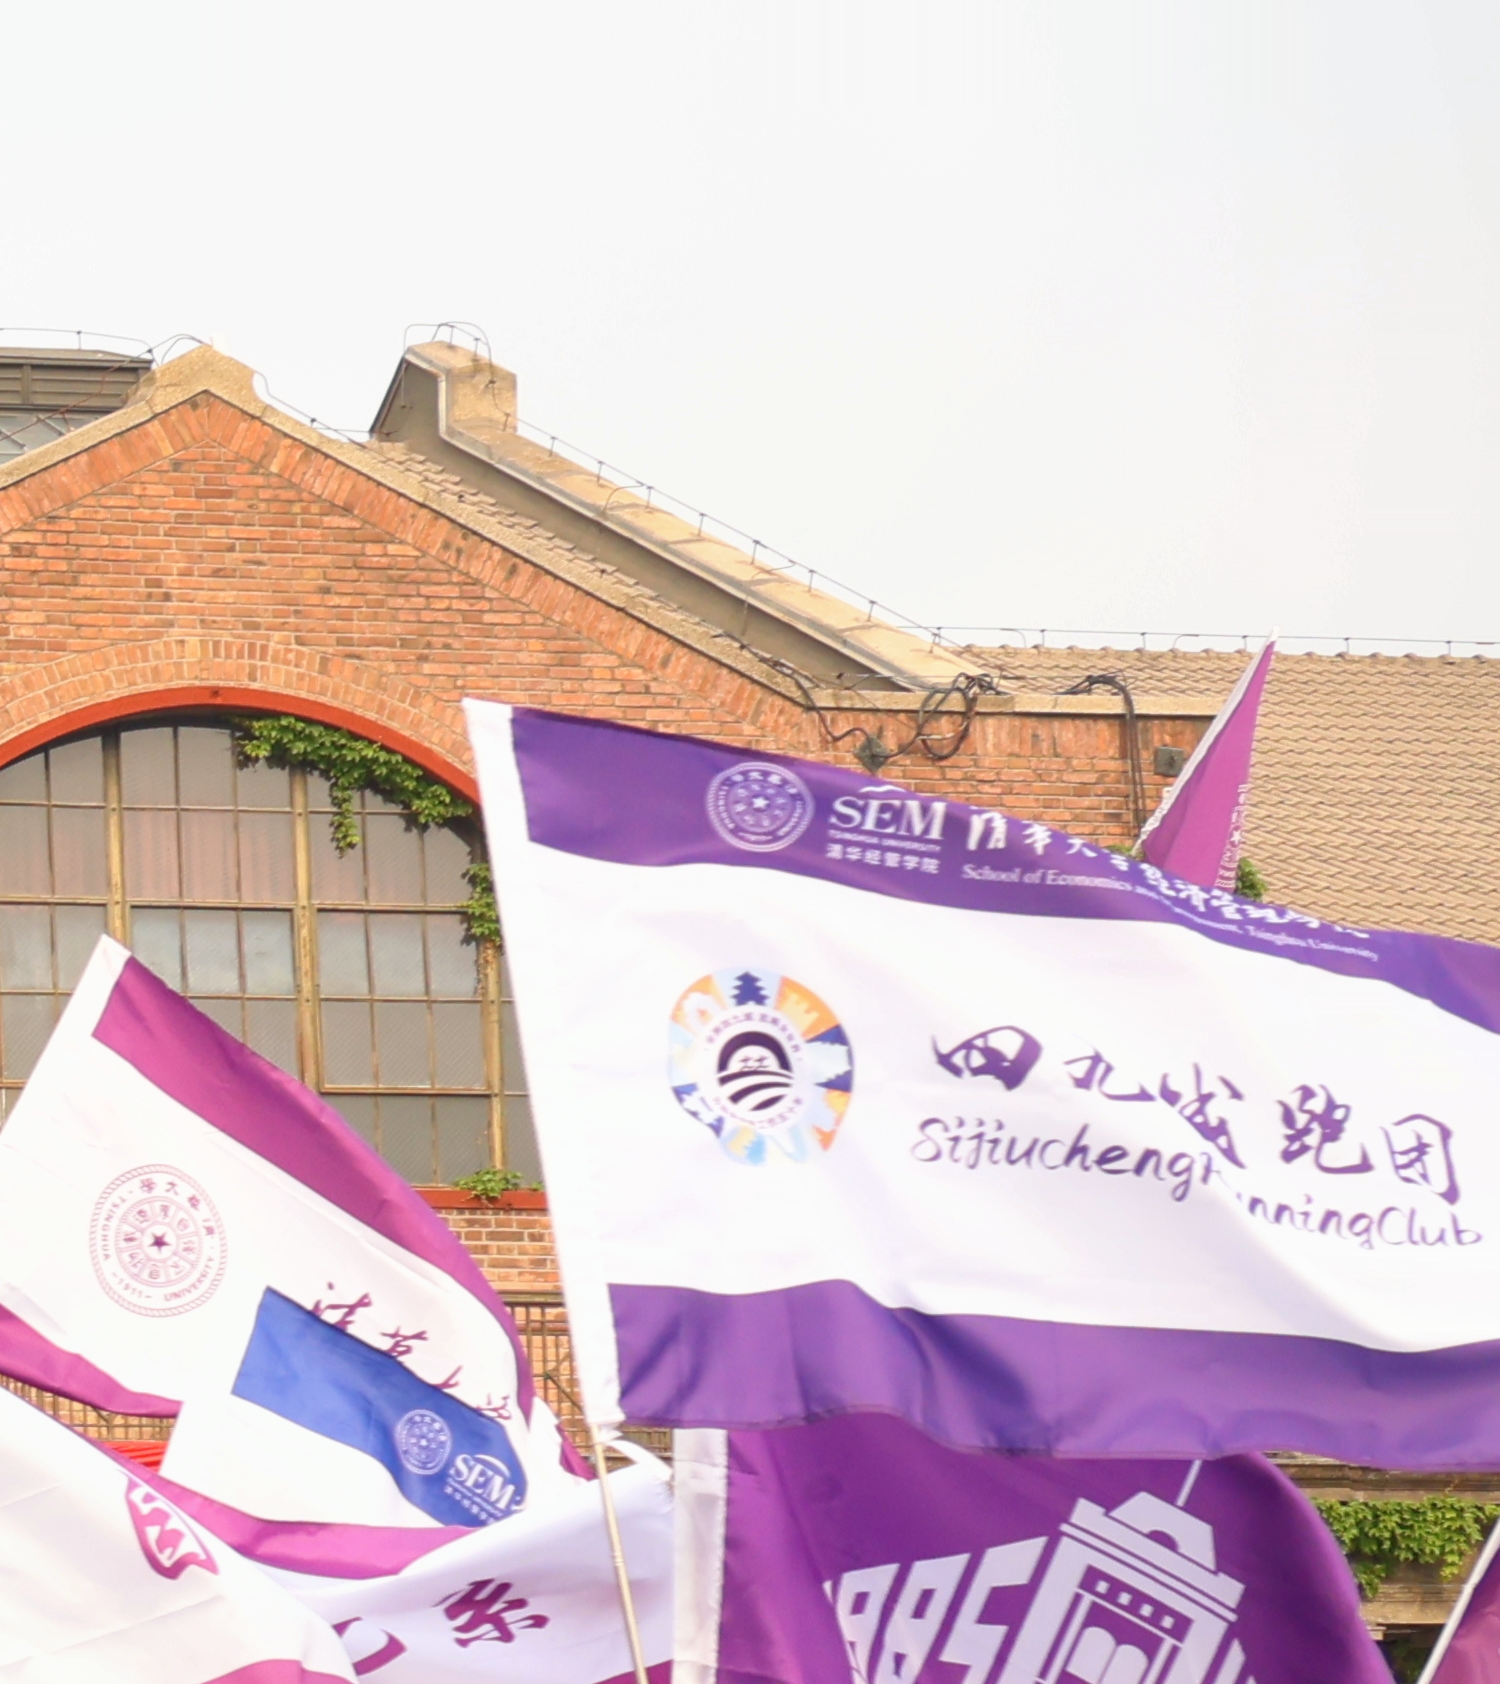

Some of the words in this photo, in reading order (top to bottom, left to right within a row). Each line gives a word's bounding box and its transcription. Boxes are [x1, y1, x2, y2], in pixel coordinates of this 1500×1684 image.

[830, 795, 947, 841] SEM
[962, 864, 1021, 884] School
[1023, 869, 1045, 885] of
[448, 1453, 516, 1510] SEM
